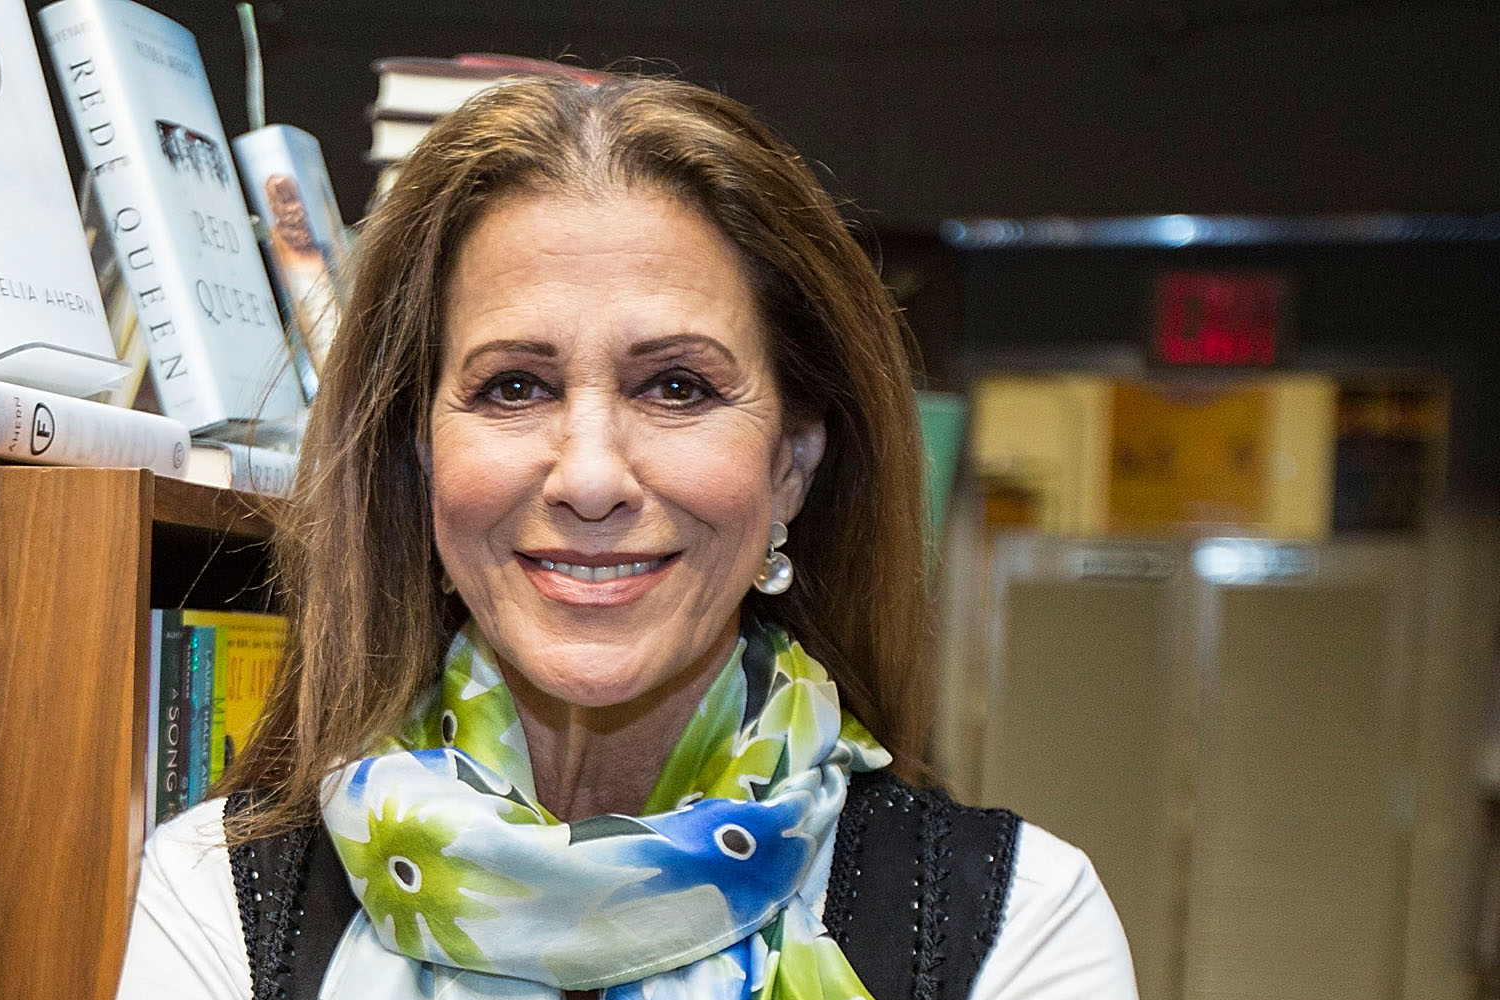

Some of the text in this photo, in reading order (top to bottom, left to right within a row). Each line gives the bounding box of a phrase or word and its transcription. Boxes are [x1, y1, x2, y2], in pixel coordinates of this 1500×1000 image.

[70, 59, 116, 147] RED
[114, 207, 187, 380] QUEEN
[193, 210, 240, 254] RED
[46, 290, 94, 315] AHERN
[7, 395, 21, 453] AHERN
[171, 688, 179, 700] A
[203, 650, 212, 706] LAURIE
[167, 706, 180, 792] SONG
[202, 711, 210, 760] HALSE
